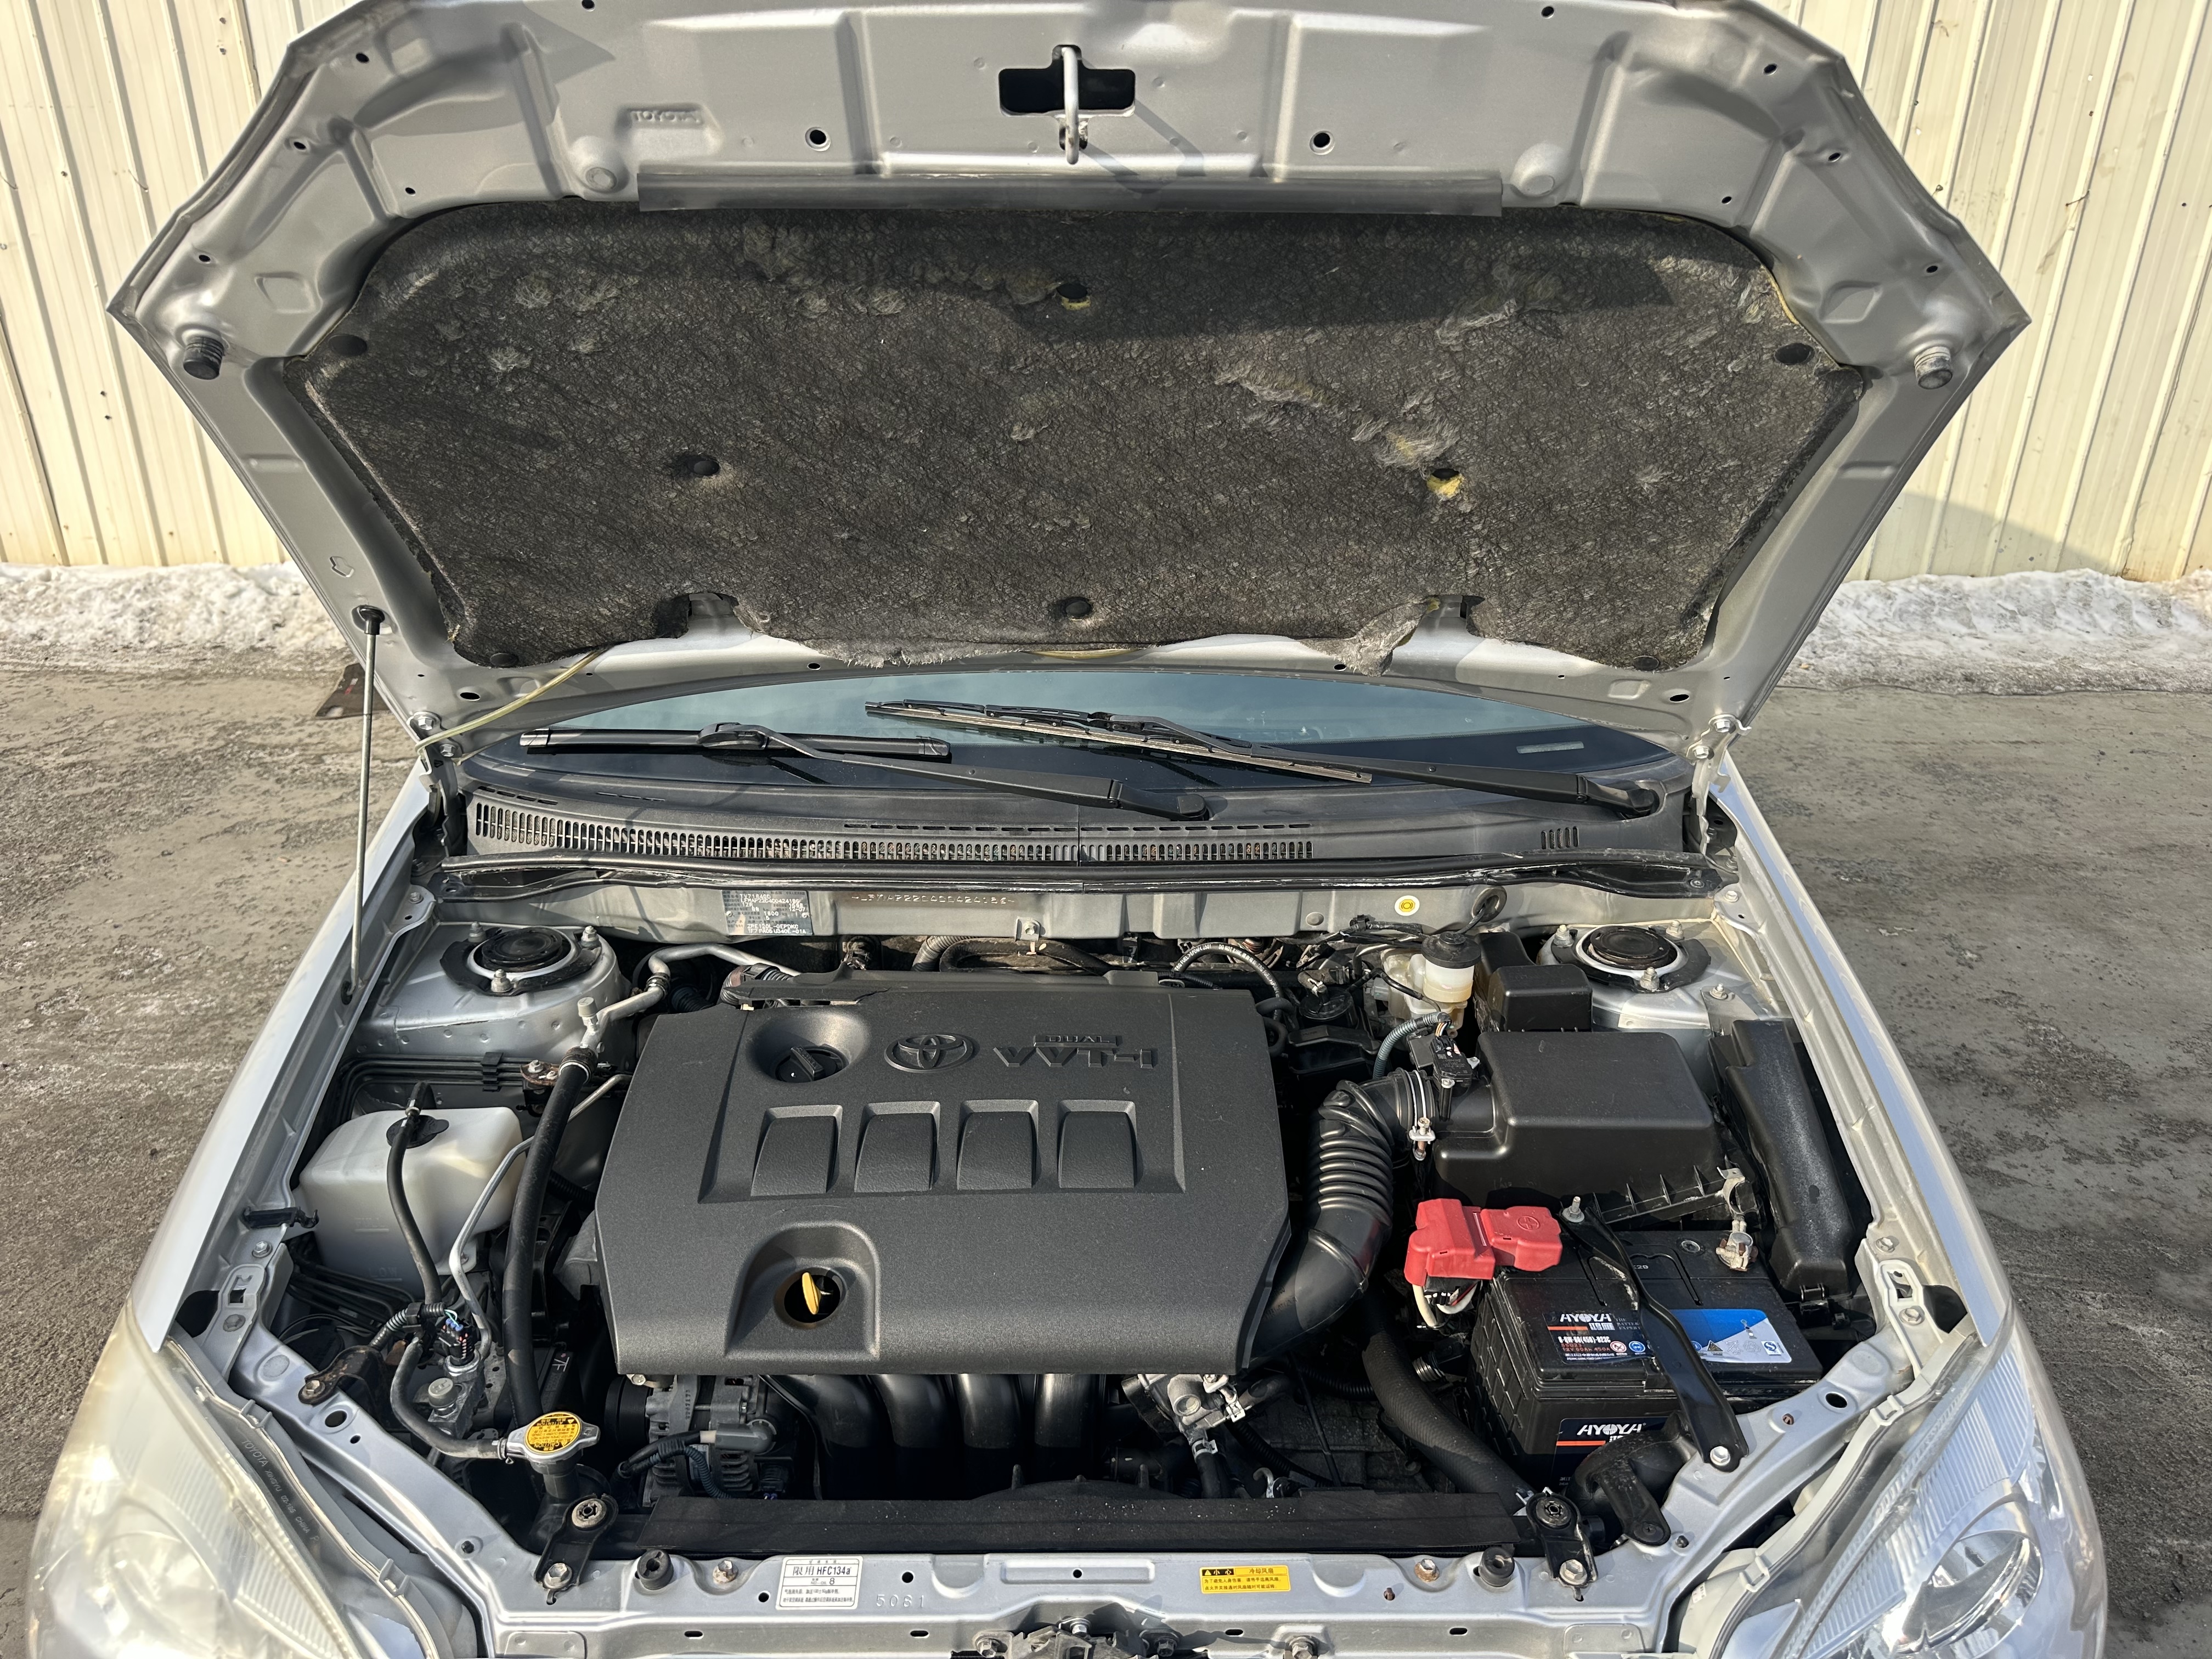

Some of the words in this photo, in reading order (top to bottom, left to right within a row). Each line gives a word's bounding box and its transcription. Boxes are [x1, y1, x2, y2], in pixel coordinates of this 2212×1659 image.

[369, 1267, 397, 1278] LOW
[241, 1440, 269, 1467] TOYOTA
[295, 1515, 311, 1534] CHINA
[793, 1566, 814, 1576] 限用
[817, 1566, 851, 1575] HFC134a
[876, 1594, 924, 1607] 5081
